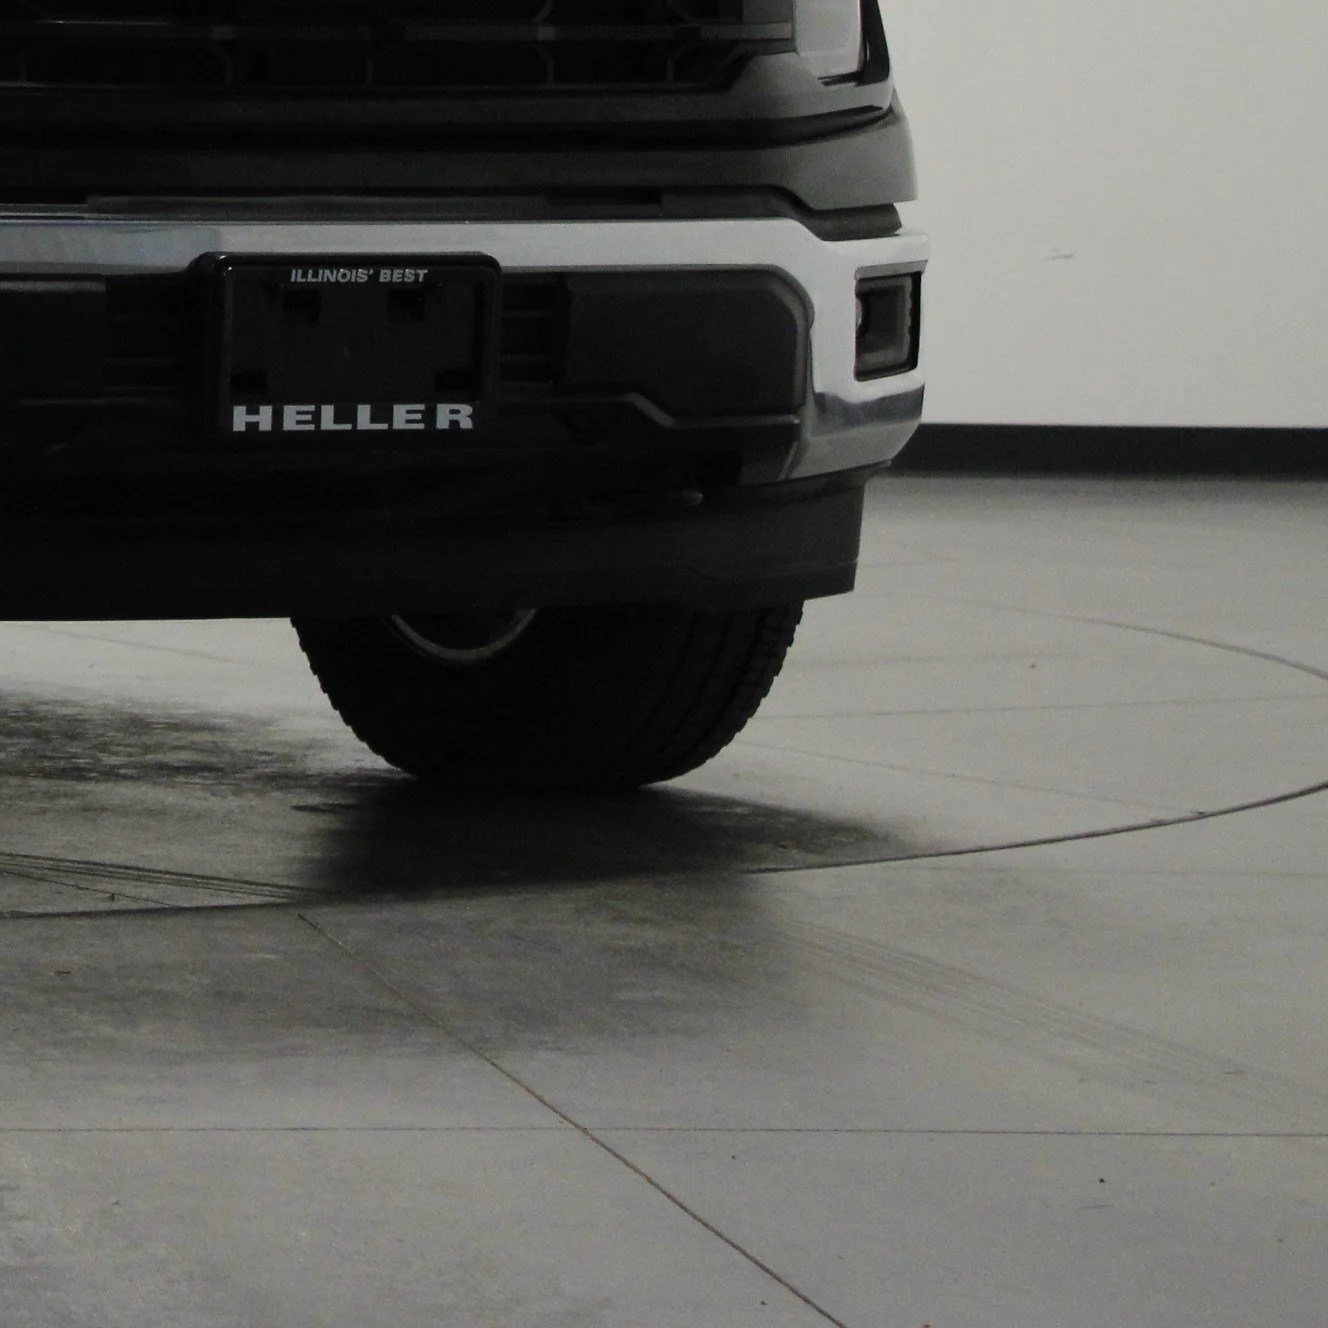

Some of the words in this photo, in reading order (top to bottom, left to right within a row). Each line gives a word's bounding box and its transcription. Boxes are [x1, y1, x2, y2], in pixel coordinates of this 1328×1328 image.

[290, 268, 374, 284] ILLINOIS'
[378, 269, 428, 283] BEST
[232, 403, 474, 432] HELLER
